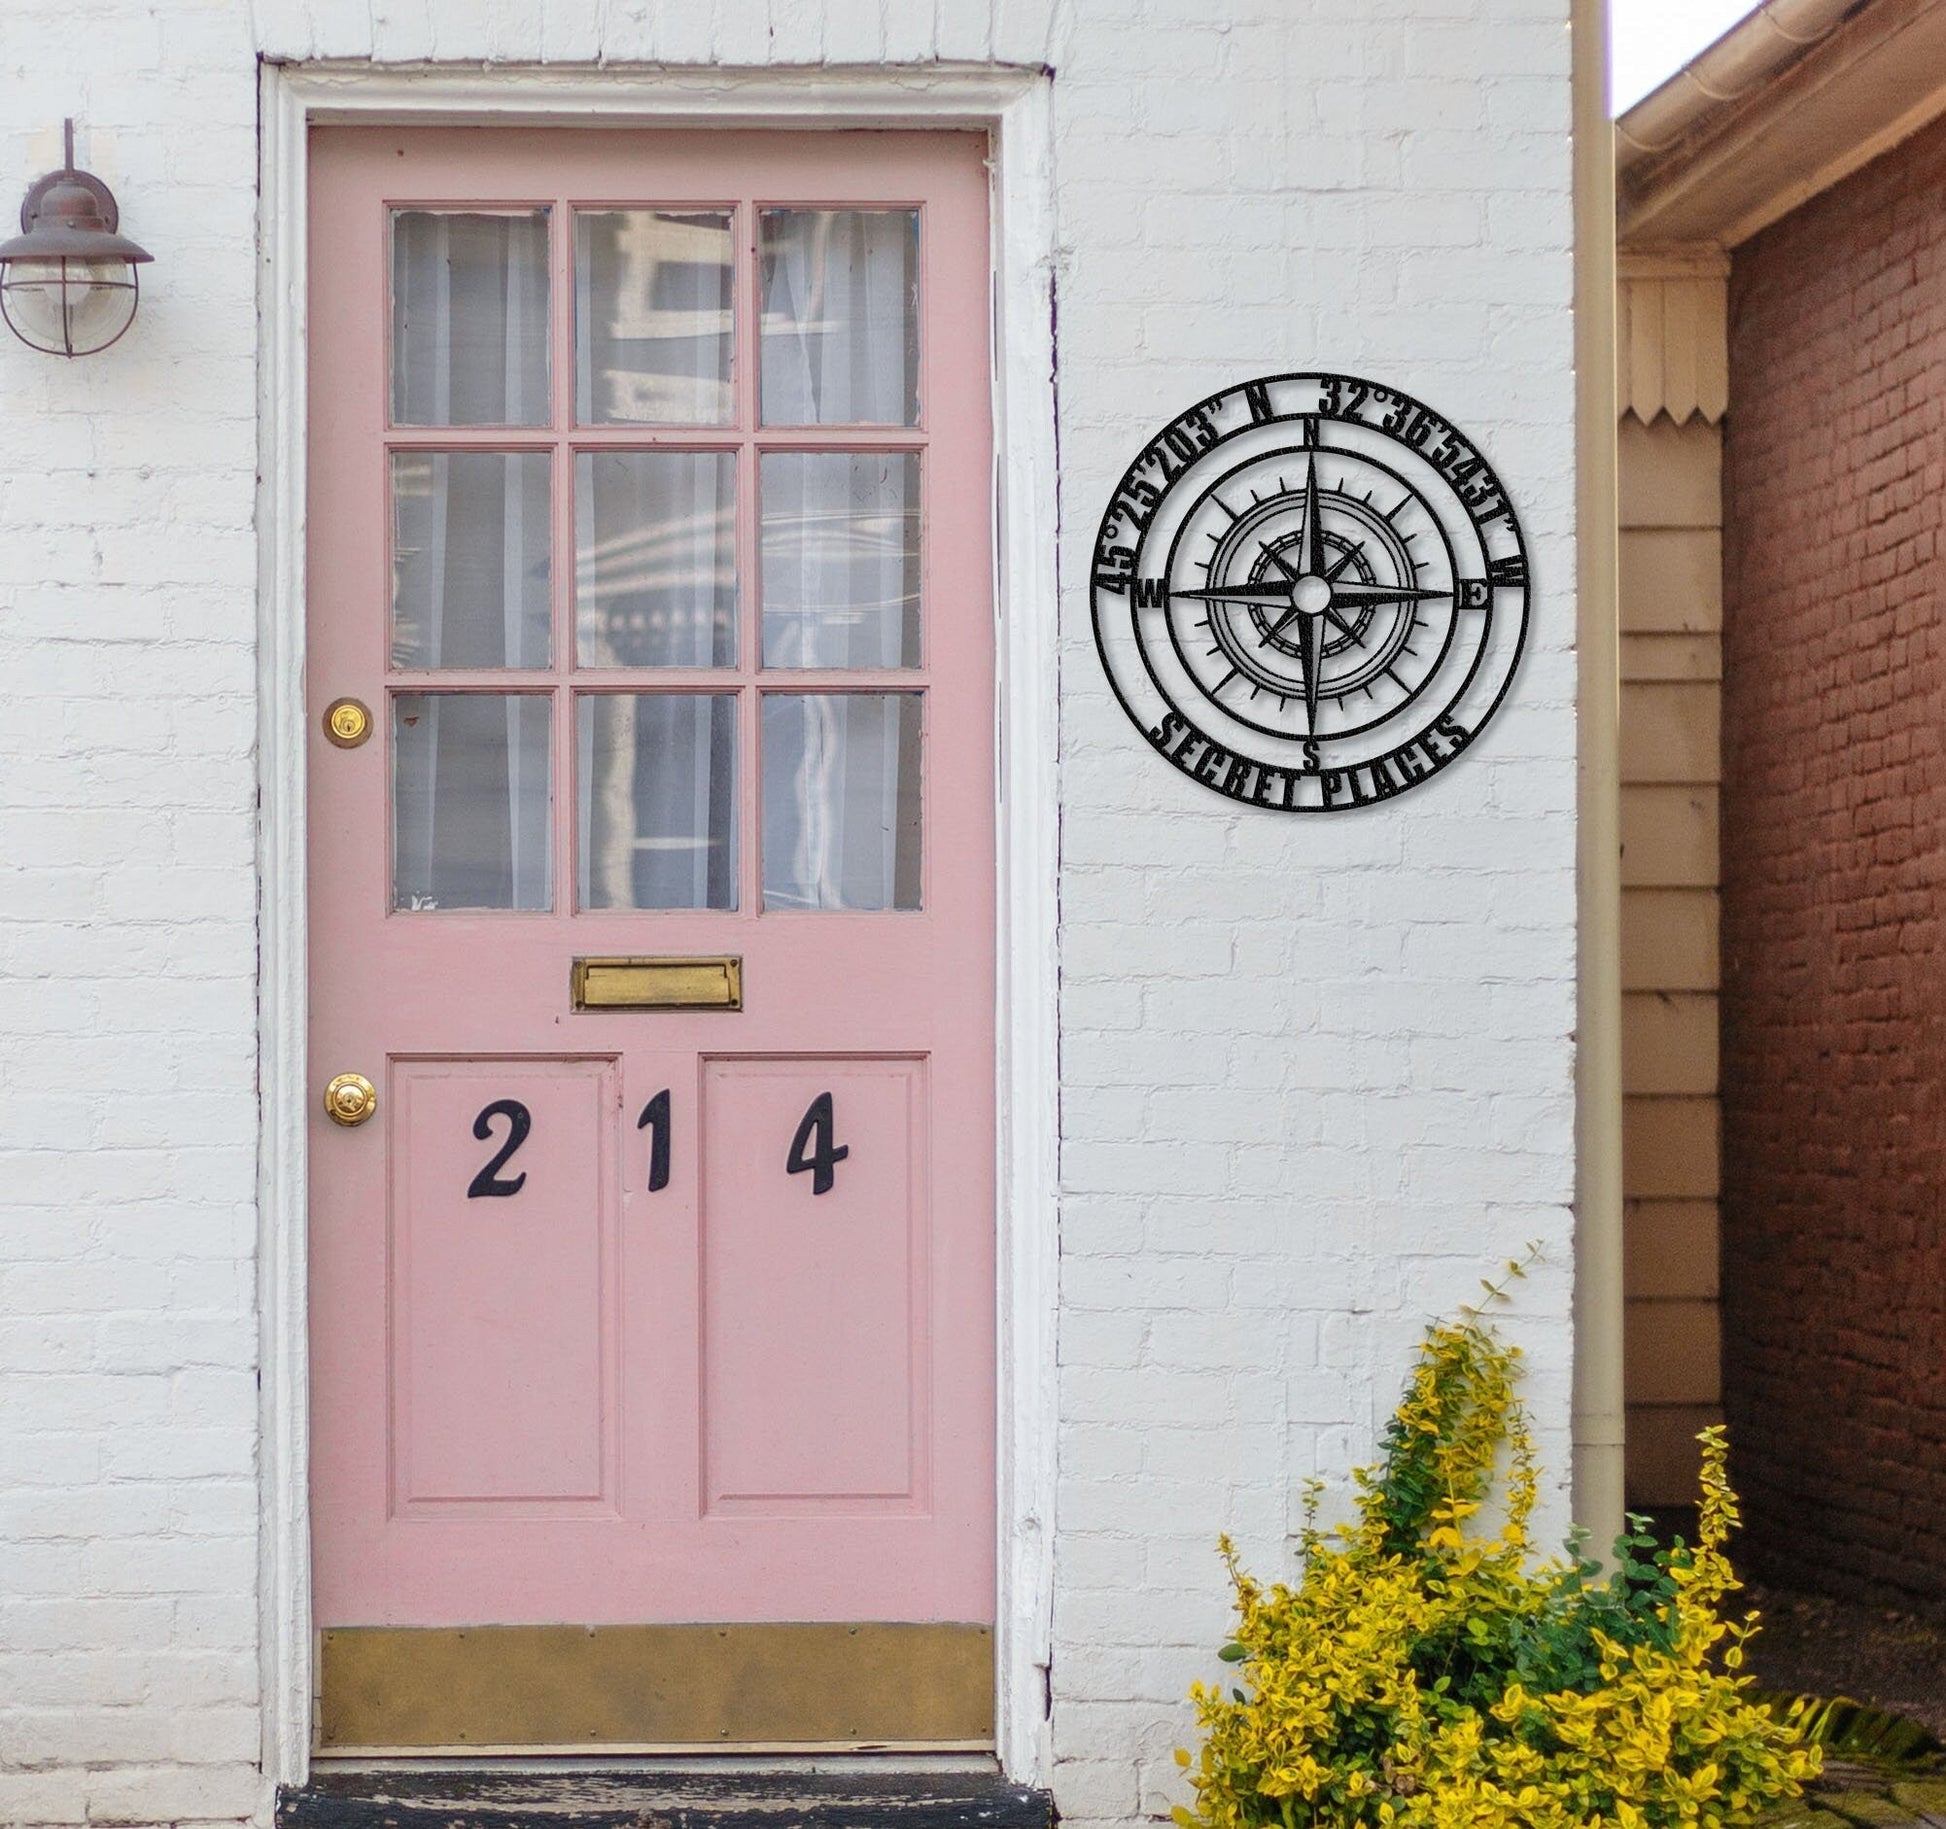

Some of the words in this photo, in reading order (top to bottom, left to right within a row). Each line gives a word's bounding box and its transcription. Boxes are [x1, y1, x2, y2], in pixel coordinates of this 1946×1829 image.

[1302, 416, 1320, 448] N
[1245, 382, 1274, 425] N
[1488, 555, 1526, 587] W
[1137, 578, 1166, 610] W
[1459, 578, 1488, 610] E
[1148, 711, 1302, 806] SECRET
[1319, 713, 1471, 806] PLACES
[1303, 738, 1320, 771] S
